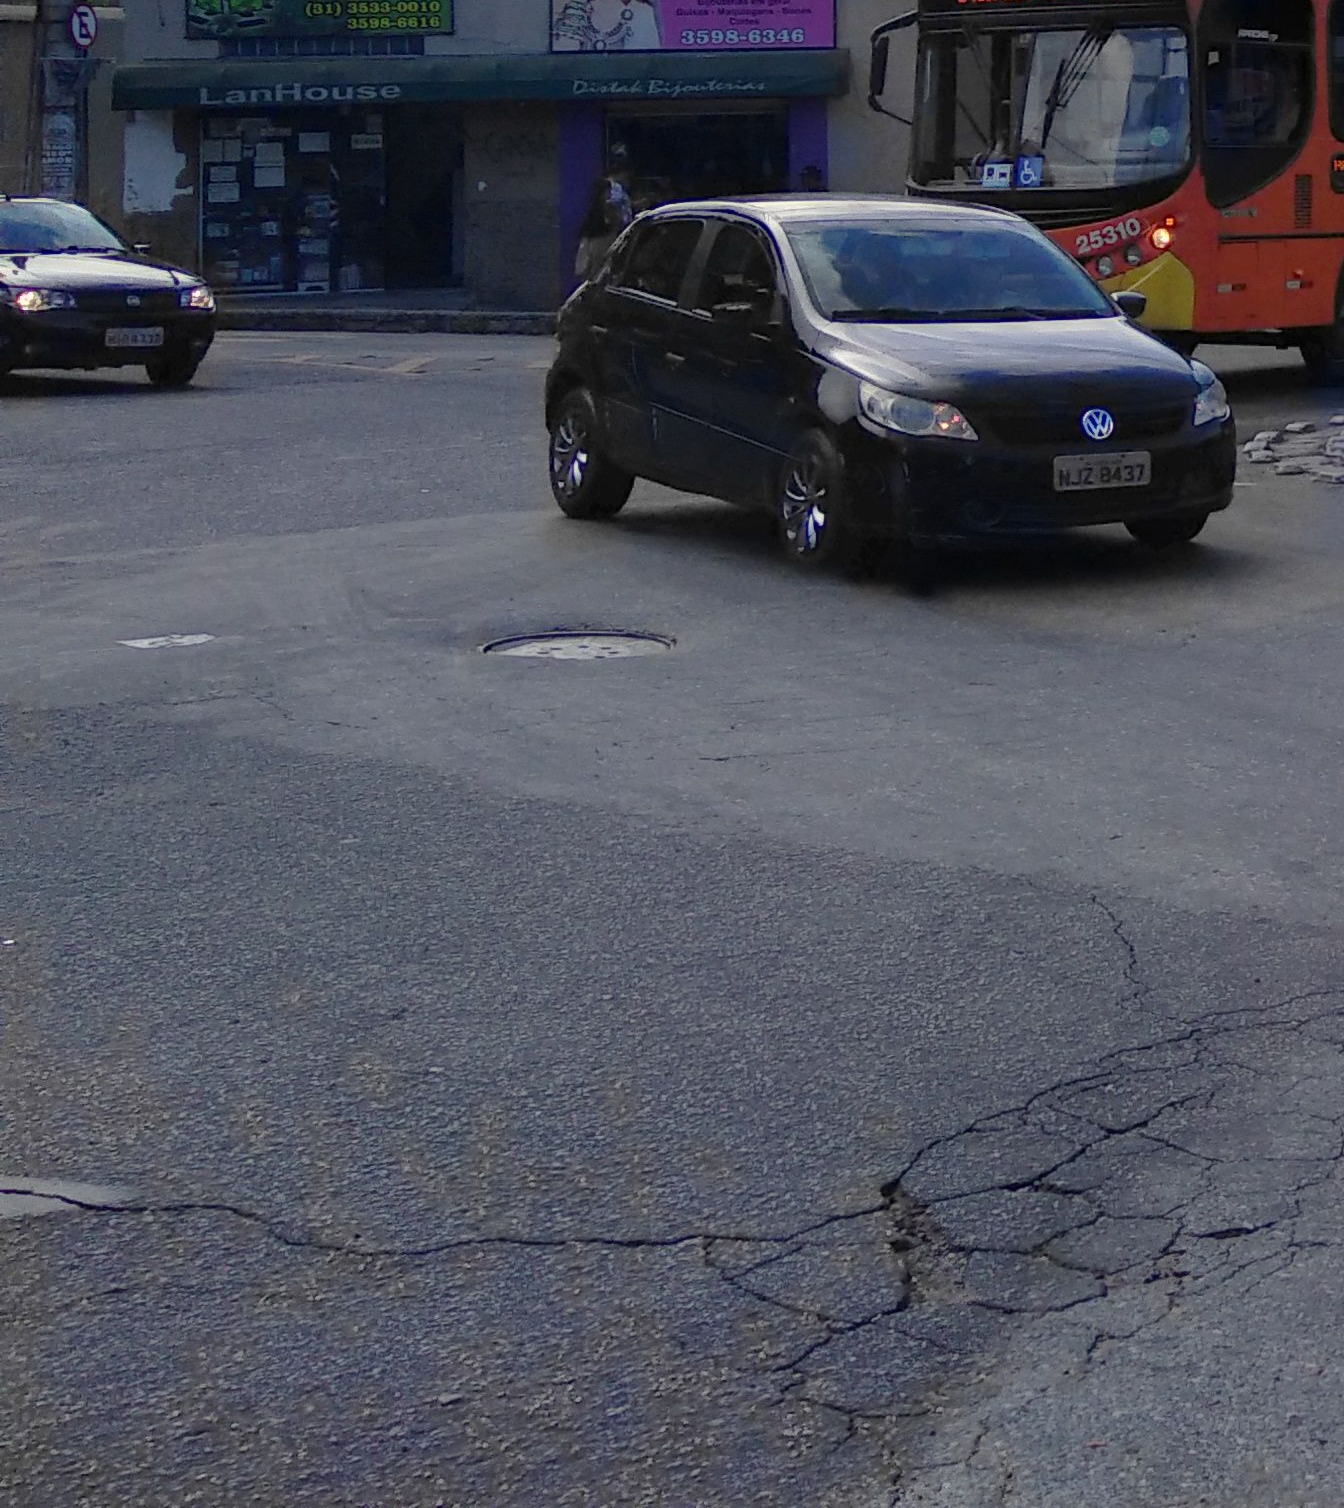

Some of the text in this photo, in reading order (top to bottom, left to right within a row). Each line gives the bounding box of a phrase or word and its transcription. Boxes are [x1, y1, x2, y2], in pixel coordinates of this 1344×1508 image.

[305, 1, 440, 17] (31) 3533-0010
[346, 17, 440, 29] 3598-6616
[681, 28, 805, 44] 3598-6346
[200, 83, 401, 105] LanHouse
[572, 79, 768, 97] Distak Bijouterias
[1076, 218, 1141, 254] 25310
[1100, 464, 1145, 483] 8437
